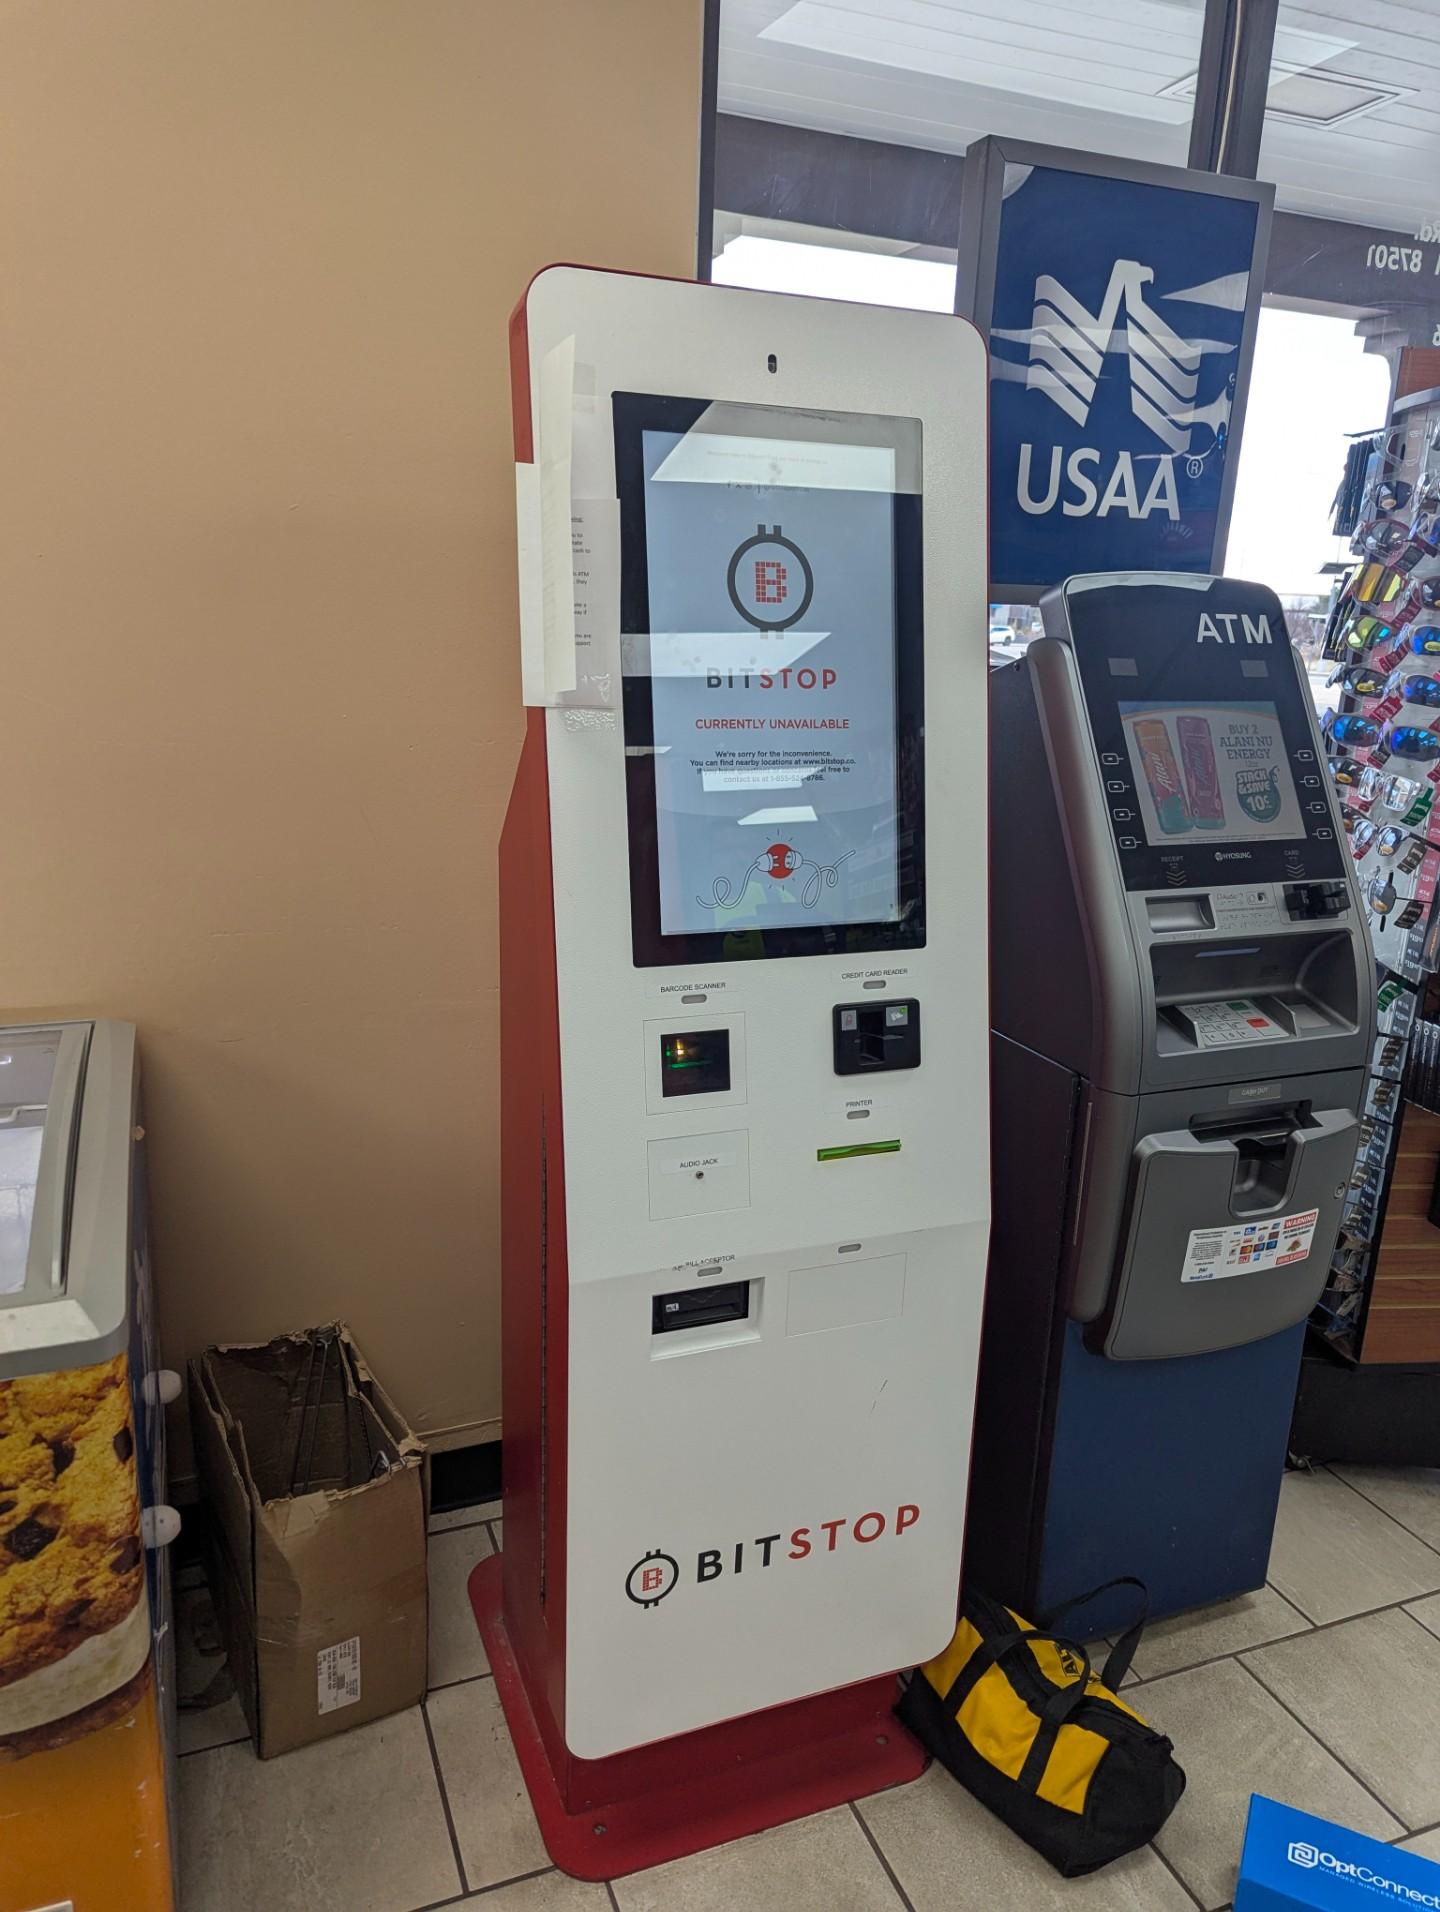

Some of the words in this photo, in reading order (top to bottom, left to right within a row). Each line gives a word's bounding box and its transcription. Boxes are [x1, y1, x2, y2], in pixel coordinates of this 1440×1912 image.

[1017, 443, 1180, 521] USAA
[1197, 613, 1272, 644] ATM
[707, 667, 837, 690] BITSTOP
[695, 719, 765, 730] CURRENTLY
[769, 719, 849, 729] UNAVAILABLE
[1228, 724, 1249, 734] BUY
[1253, 724, 1259, 734] 2
[1220, 736, 1255, 747] ALANI
[1257, 736, 1272, 747] NU
[1227, 748, 1270, 759] ENERGY
[841, 971, 864, 980] CREDIT
[865, 970, 882, 978] CARD
[883, 968, 908, 977] READER
[660, 984, 693, 993] BARCODE
[694, 982, 726, 991] SCANNER
[846, 1099, 873, 1108] PRINTER
[680, 1160, 700, 1169] AUDIO
[702, 1158, 718, 1166] JACK
[697, 1504, 920, 1583] BITSTOP
[1319, 1853, 1440, 1910] OptConnect
